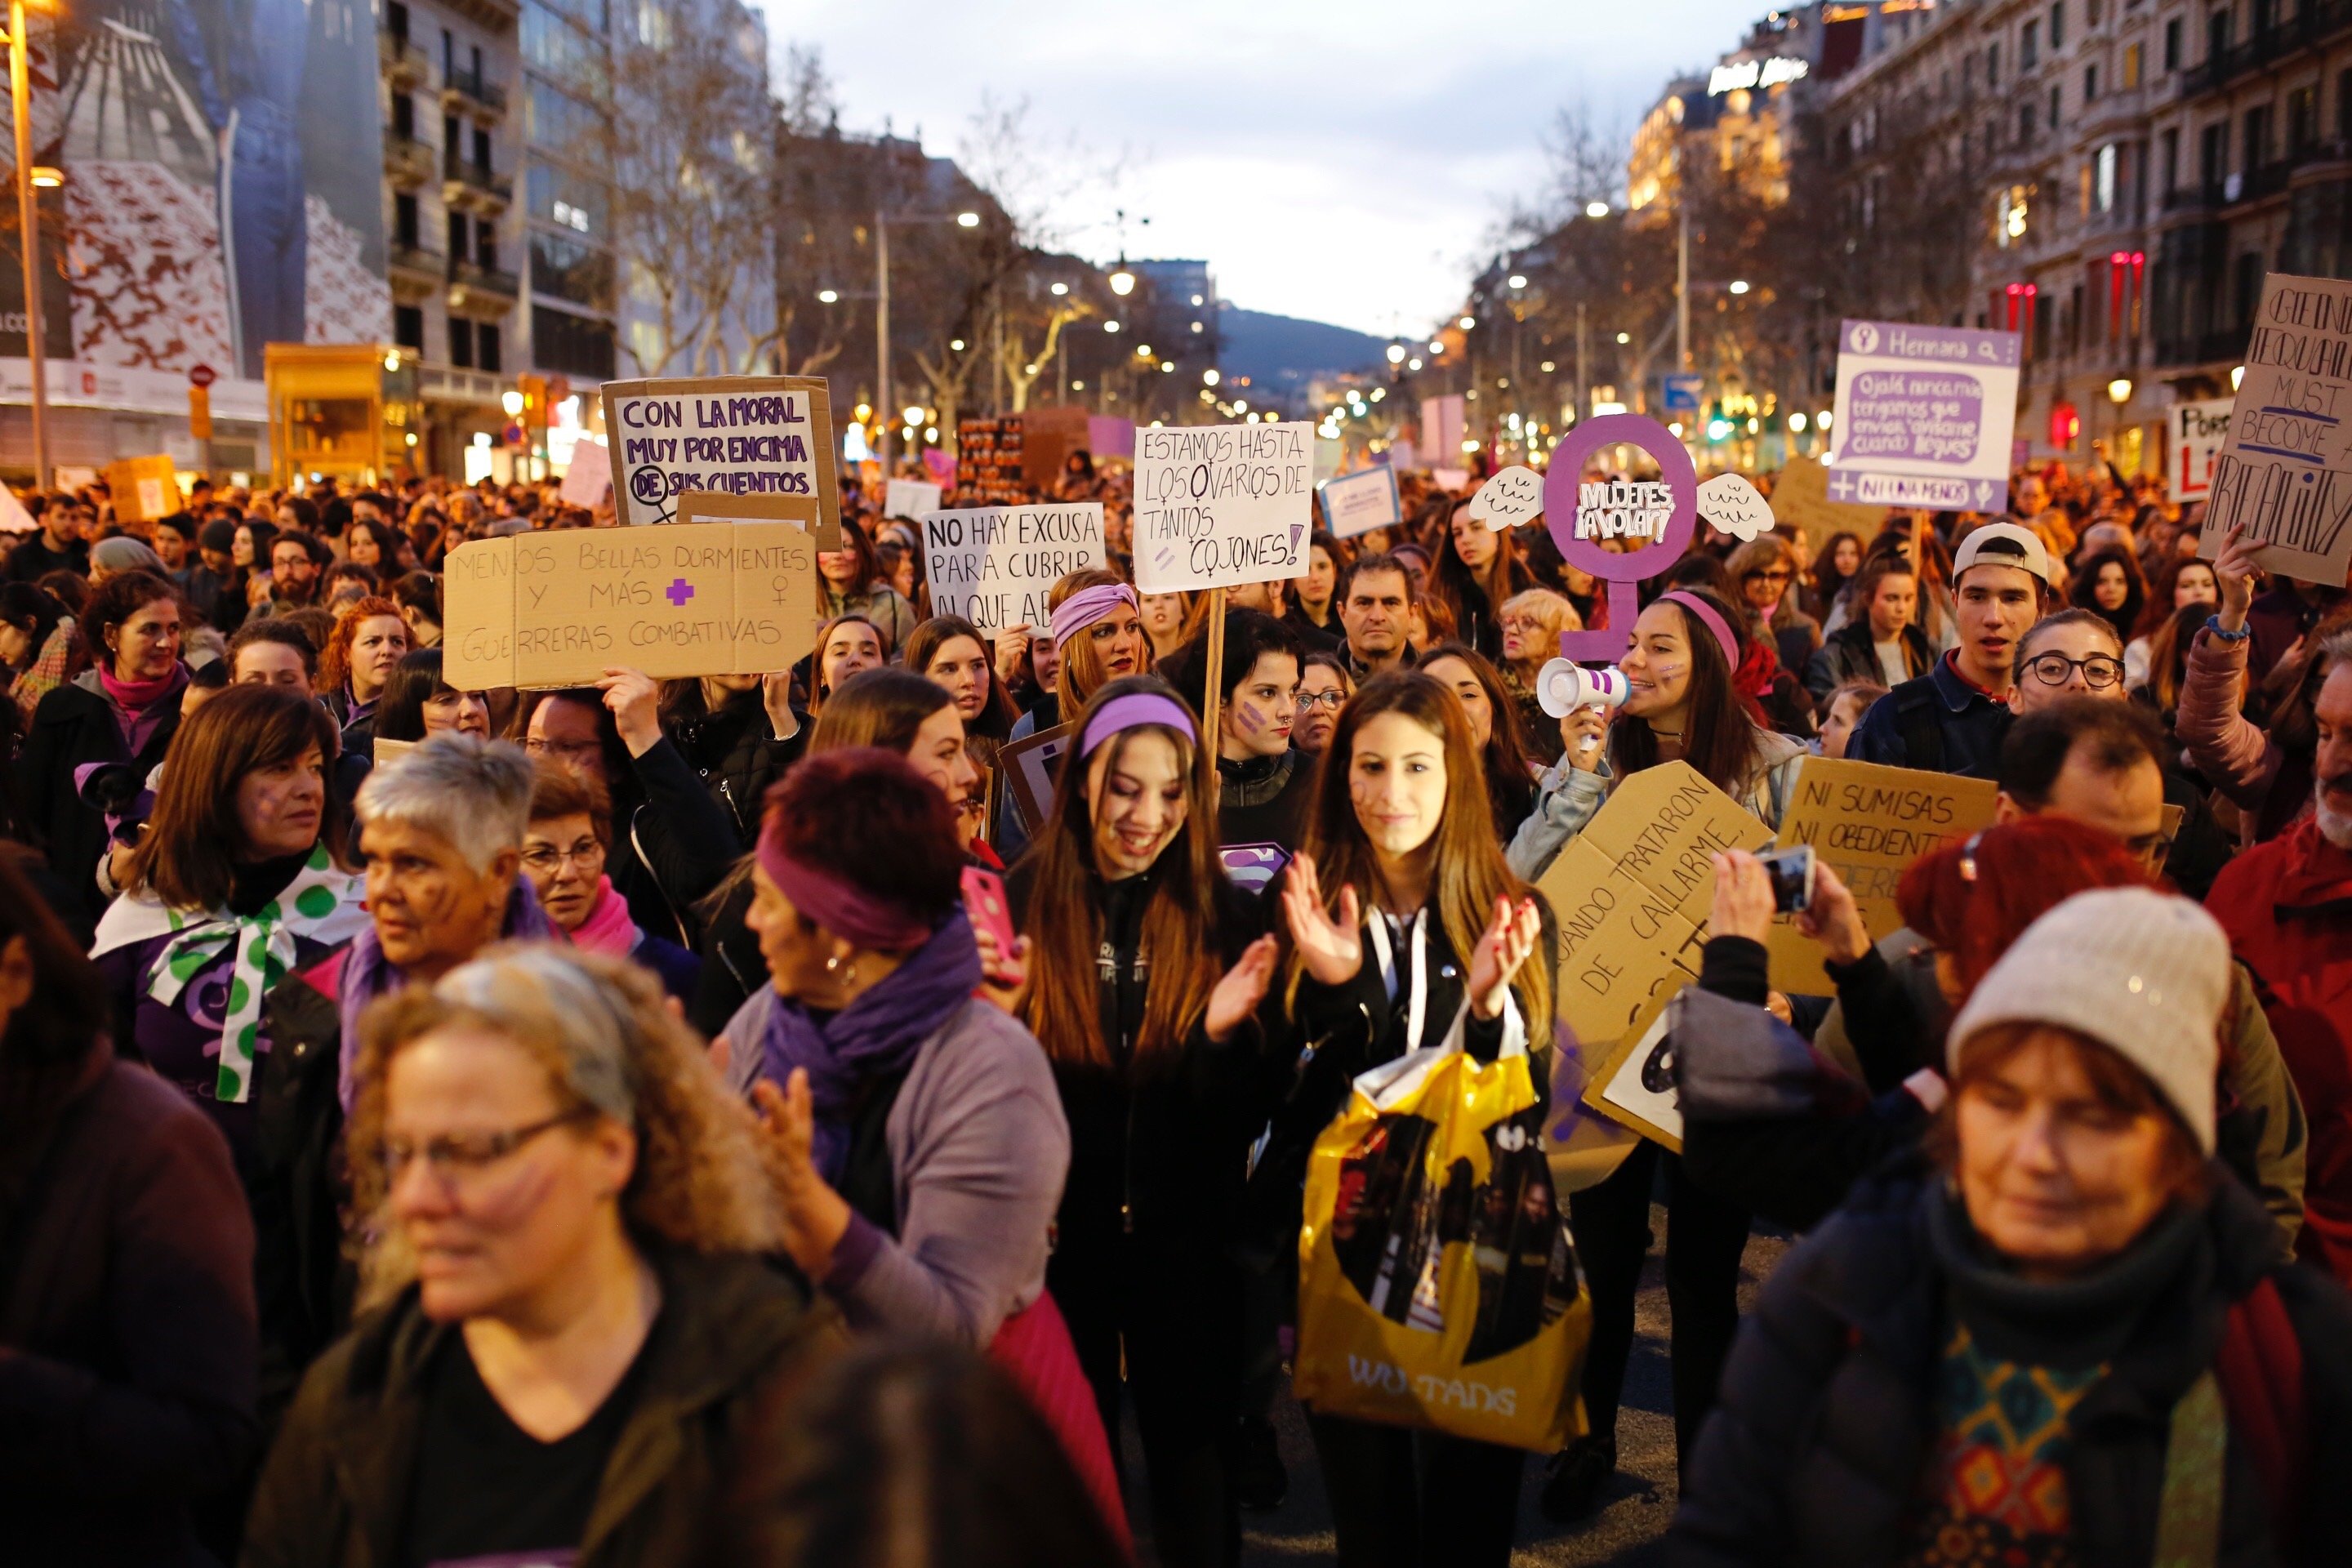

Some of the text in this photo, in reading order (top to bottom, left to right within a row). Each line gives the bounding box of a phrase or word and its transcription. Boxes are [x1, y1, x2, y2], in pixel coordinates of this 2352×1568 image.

[1889, 329, 1969, 359] Hermana
[623, 396, 804, 428] CON LA MORAL
[2271, 375, 2345, 417] MUST
[626, 435, 808, 464] MUY POR ENCIMA
[1144, 428, 1304, 463] ESTAMOS HASTA
[2240, 410, 2336, 457] BECOME
[636, 471, 810, 497] DE SUS CUENTOS
[1145, 466, 1188, 502] LOS
[1285, 466, 1307, 494] DE
[929, 511, 1098, 549] NO HAY EXCUSA
[1143, 506, 1214, 541] TANTOS
[456, 542, 809, 581] MENOS BELLAS DURMIENTES
[932, 550, 1089, 584] PARA CUBRIR
[1190, 523, 1305, 575] COJONES!
[528, 570, 653, 609] Y MÁS
[462, 617, 782, 662] GUERRERAS COMBATIVAS
[1803, 780, 1955, 824] NI SUMISAS
[1792, 821, 1820, 844] NI
[1557, 888, 1615, 969] UANDO
[1608, 773, 1710, 883] TRATARON
[1580, 954, 1624, 996] DE
